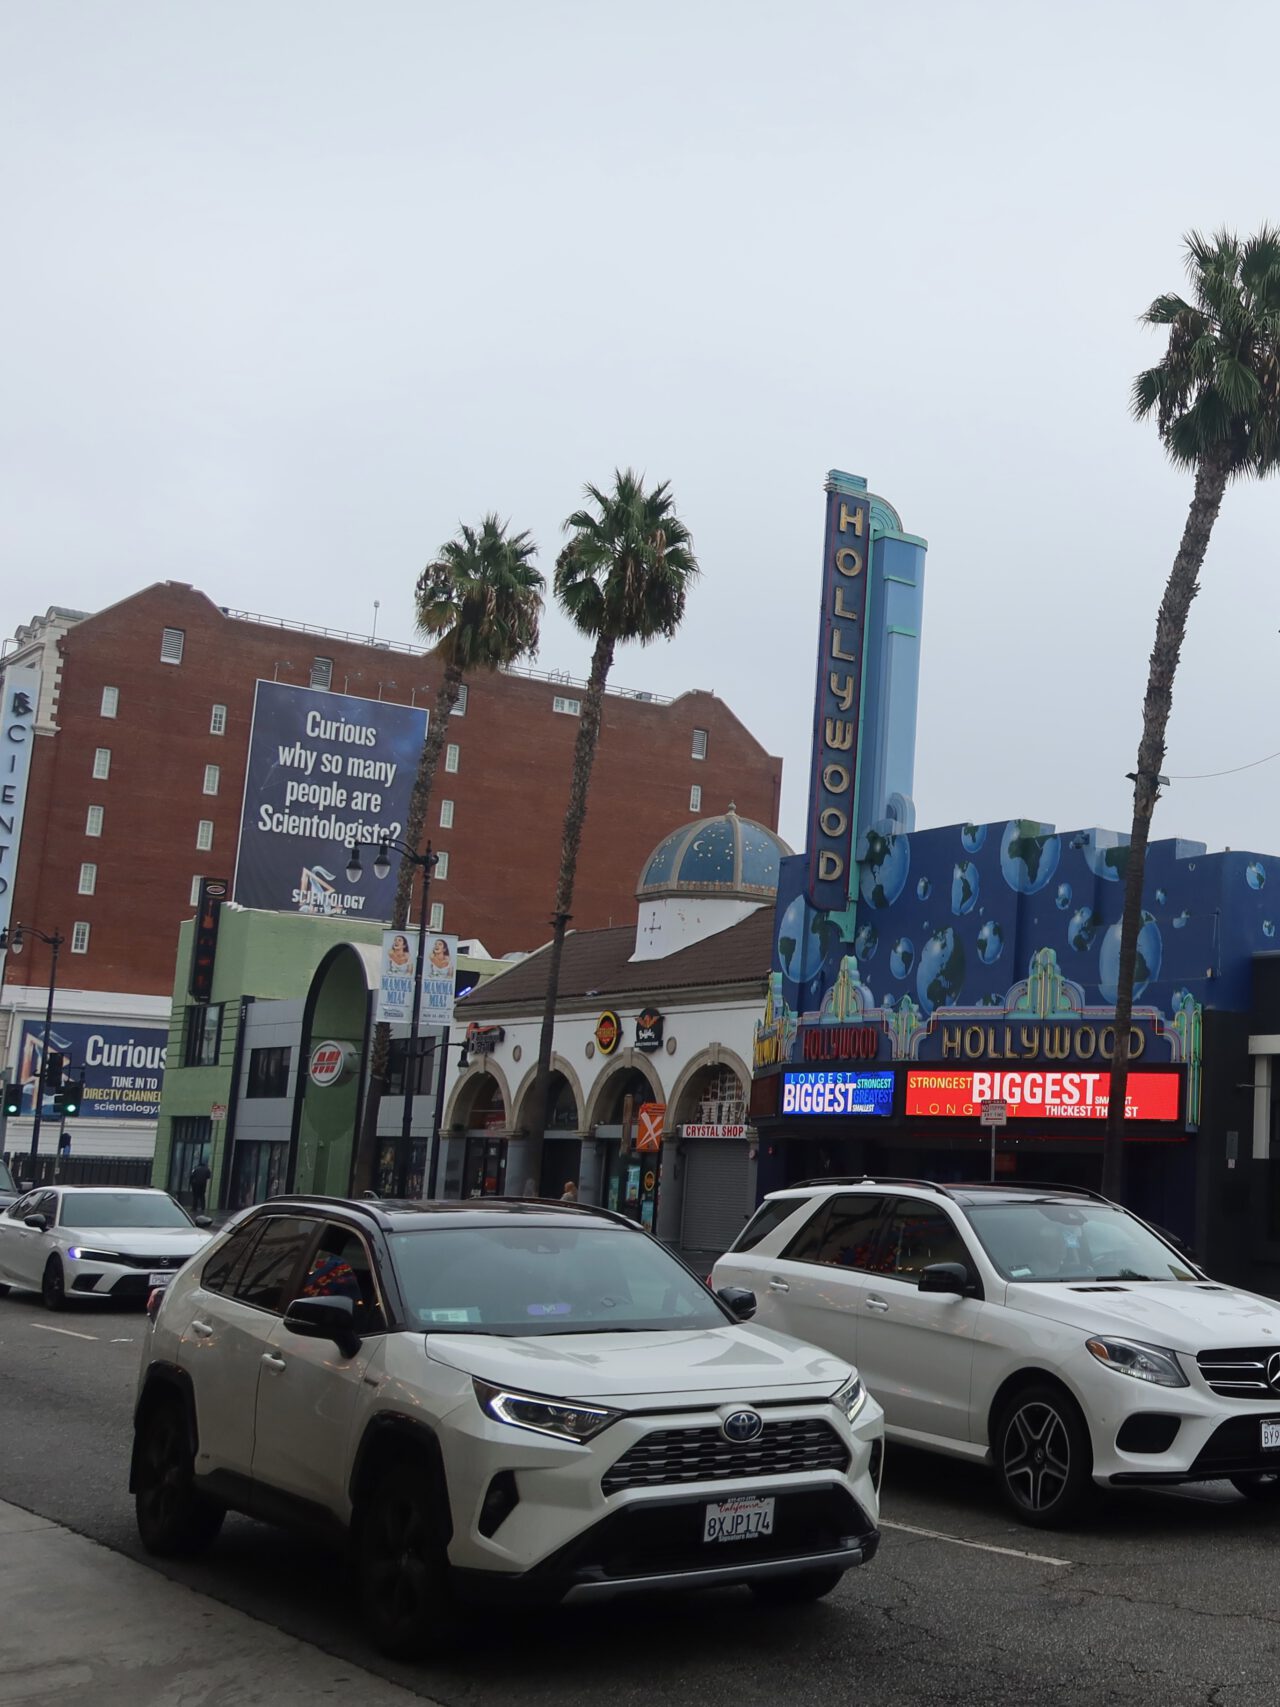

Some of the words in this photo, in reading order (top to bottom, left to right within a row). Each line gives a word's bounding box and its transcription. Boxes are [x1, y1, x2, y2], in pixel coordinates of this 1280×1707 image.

[818, 502, 864, 881] HOLLYWOOD
[306, 710, 377, 747] Curious
[278, 741, 318, 775] why
[320, 753, 342, 774] so
[347, 757, 397, 787] many
[285, 780, 347, 811] people
[351, 791, 382, 813] are
[258, 804, 402, 849] Scientologists?
[292, 888, 366, 910] SCIENTOLOGY
[803, 1027, 878, 1059] HOLLYWOOD
[942, 1024, 1146, 1060] HOLLYWOOD
[111, 1076, 134, 1088] TUNE
[135, 1077, 144, 1088] IN
[146, 1078, 158, 1089] TO
[790, 1073, 852, 1084] LONGEST
[857, 1079, 891, 1088] STRONGEST
[909, 1076, 973, 1089] STRONGEST
[972, 1073, 1100, 1105] BIGGEST
[83, 1088, 121, 1100] DIRECTV
[783, 1083, 856, 1112] BIGGEST
[853, 1090, 892, 1103] GREATEST
[1045, 1105, 1092, 1117] THICKEST
[686, 1126, 719, 1136] CRYSTAL
[722, 1127, 744, 1137] SHOP
[720, 1503, 759, 1513] California
[708, 1511, 770, 1537] 8XJP174
